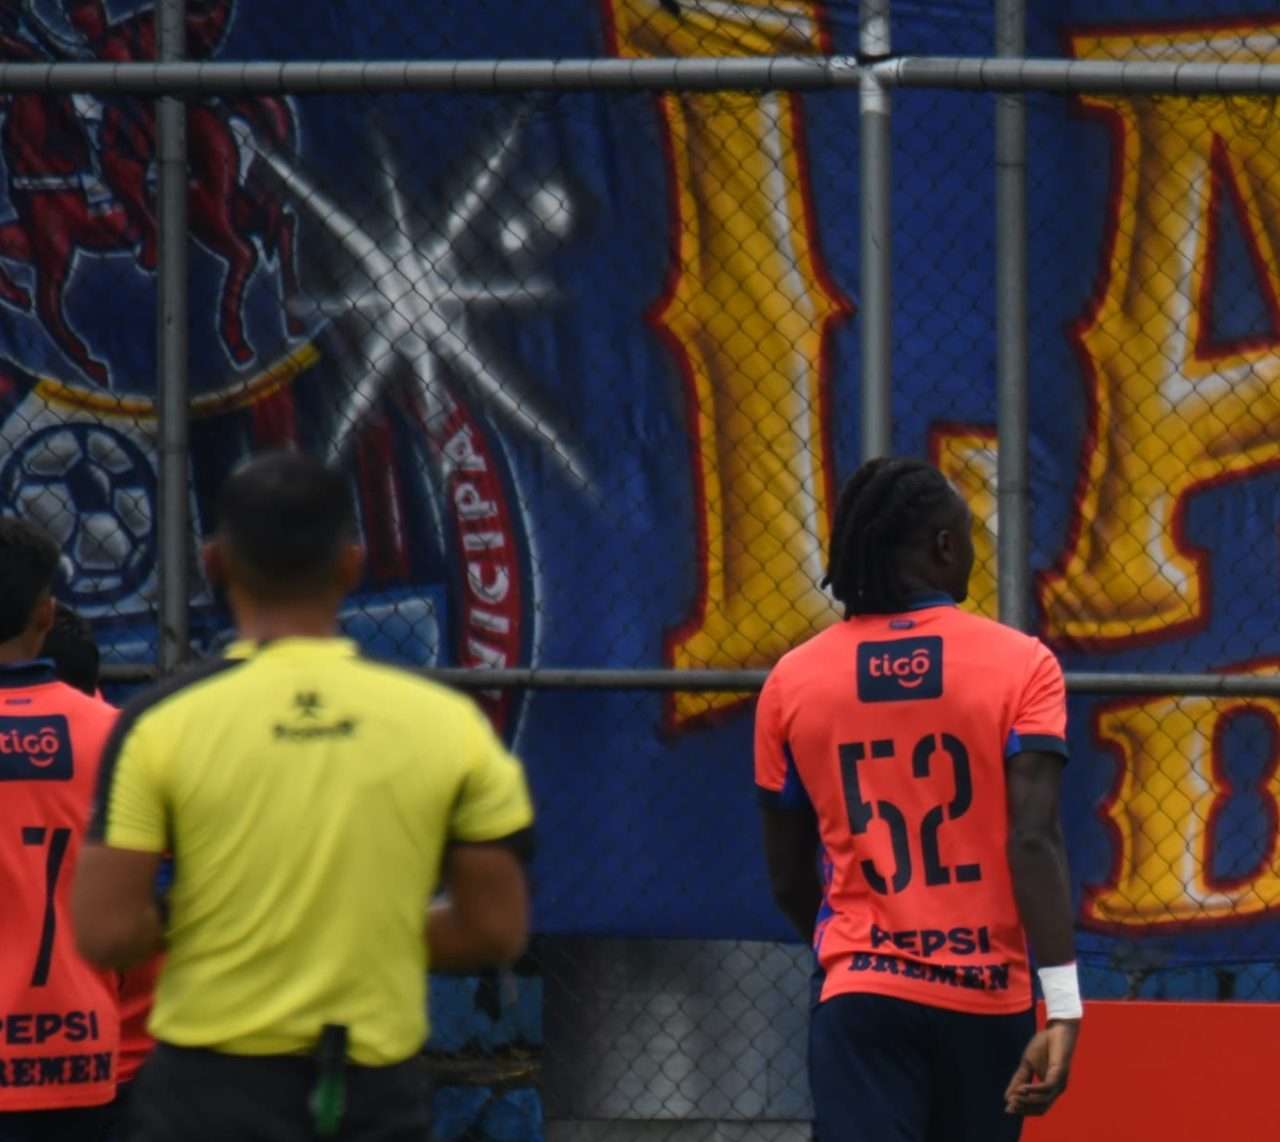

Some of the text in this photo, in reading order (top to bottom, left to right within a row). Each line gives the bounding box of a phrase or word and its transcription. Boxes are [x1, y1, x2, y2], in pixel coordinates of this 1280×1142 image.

[838, 732, 982, 896] 52
[21, 826, 72, 988] 7
[870, 923, 992, 957] PEPSI
[848, 951, 1009, 991] BREMEN
[0, 1009, 99, 1046] EPSI
